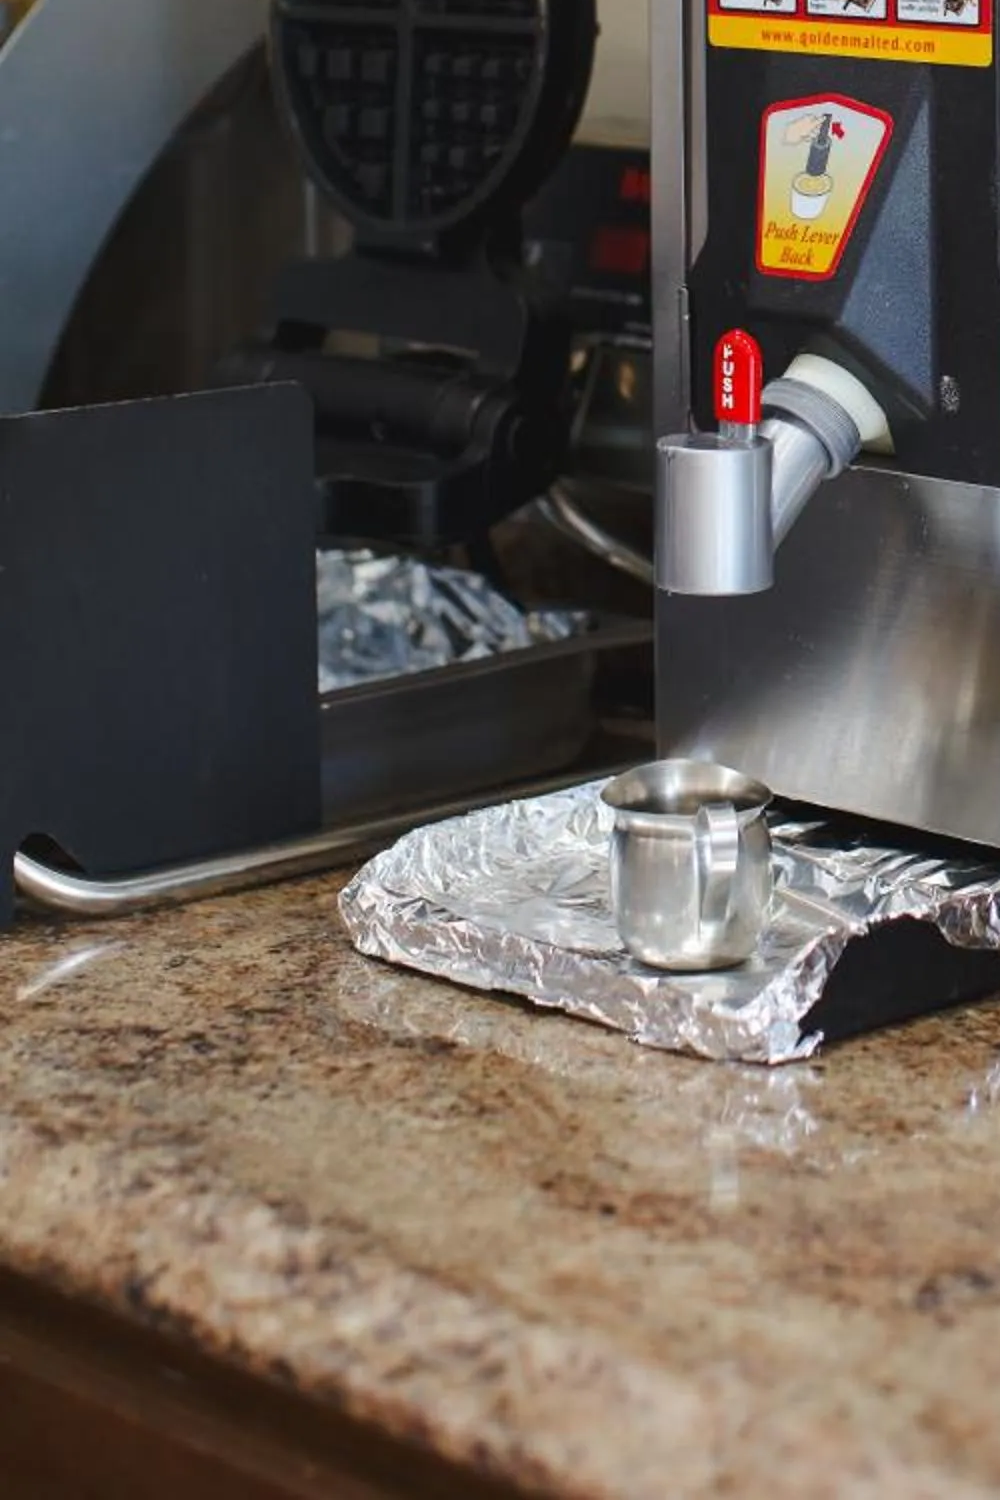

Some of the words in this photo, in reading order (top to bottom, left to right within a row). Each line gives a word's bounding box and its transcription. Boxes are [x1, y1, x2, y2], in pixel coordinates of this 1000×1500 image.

[761, 27, 936, 53] www.goldenmalted.com
[764, 221, 799, 241] Push
[799, 225, 840, 245] Lever
[779, 245, 814, 265] Back
[721, 342, 735, 410] PUSH
